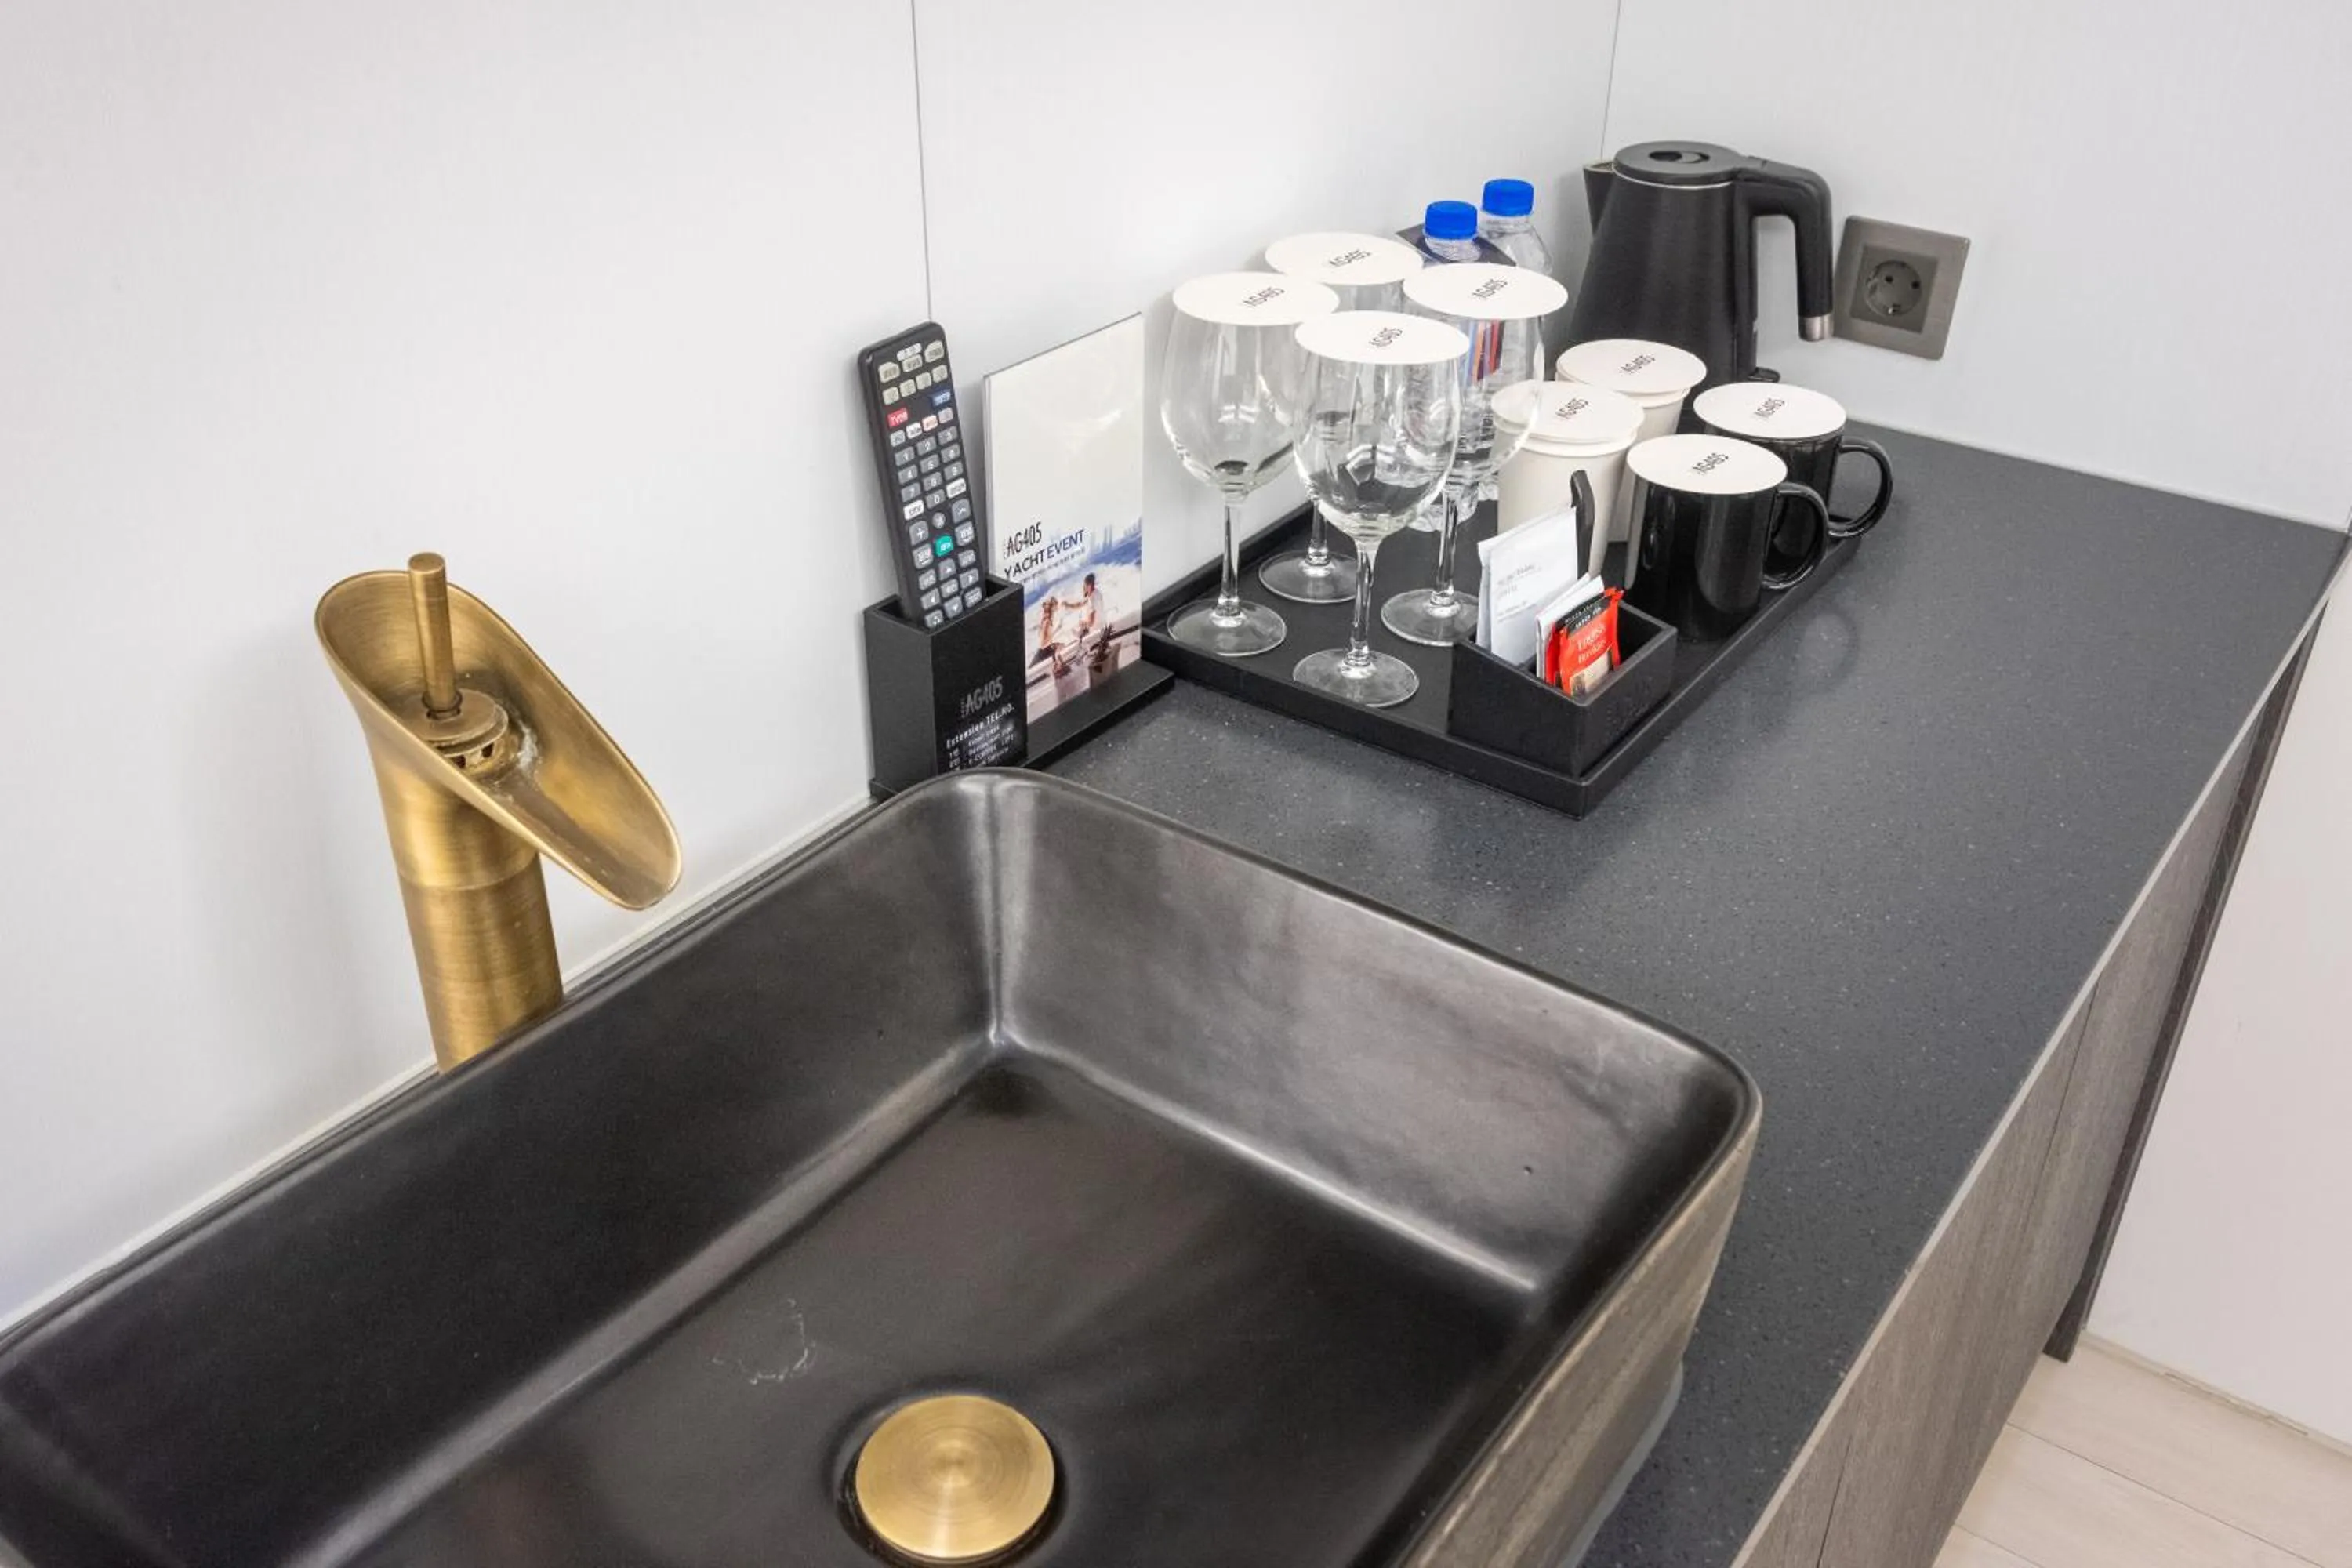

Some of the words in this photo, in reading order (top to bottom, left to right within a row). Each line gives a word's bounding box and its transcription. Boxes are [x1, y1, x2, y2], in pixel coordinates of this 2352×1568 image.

[1004, 548, 1045, 579] YACHT
[1047, 529, 1084, 559] EVENT
[1007, 521, 1042, 557] AG405
[964, 675, 1004, 715] AG405
